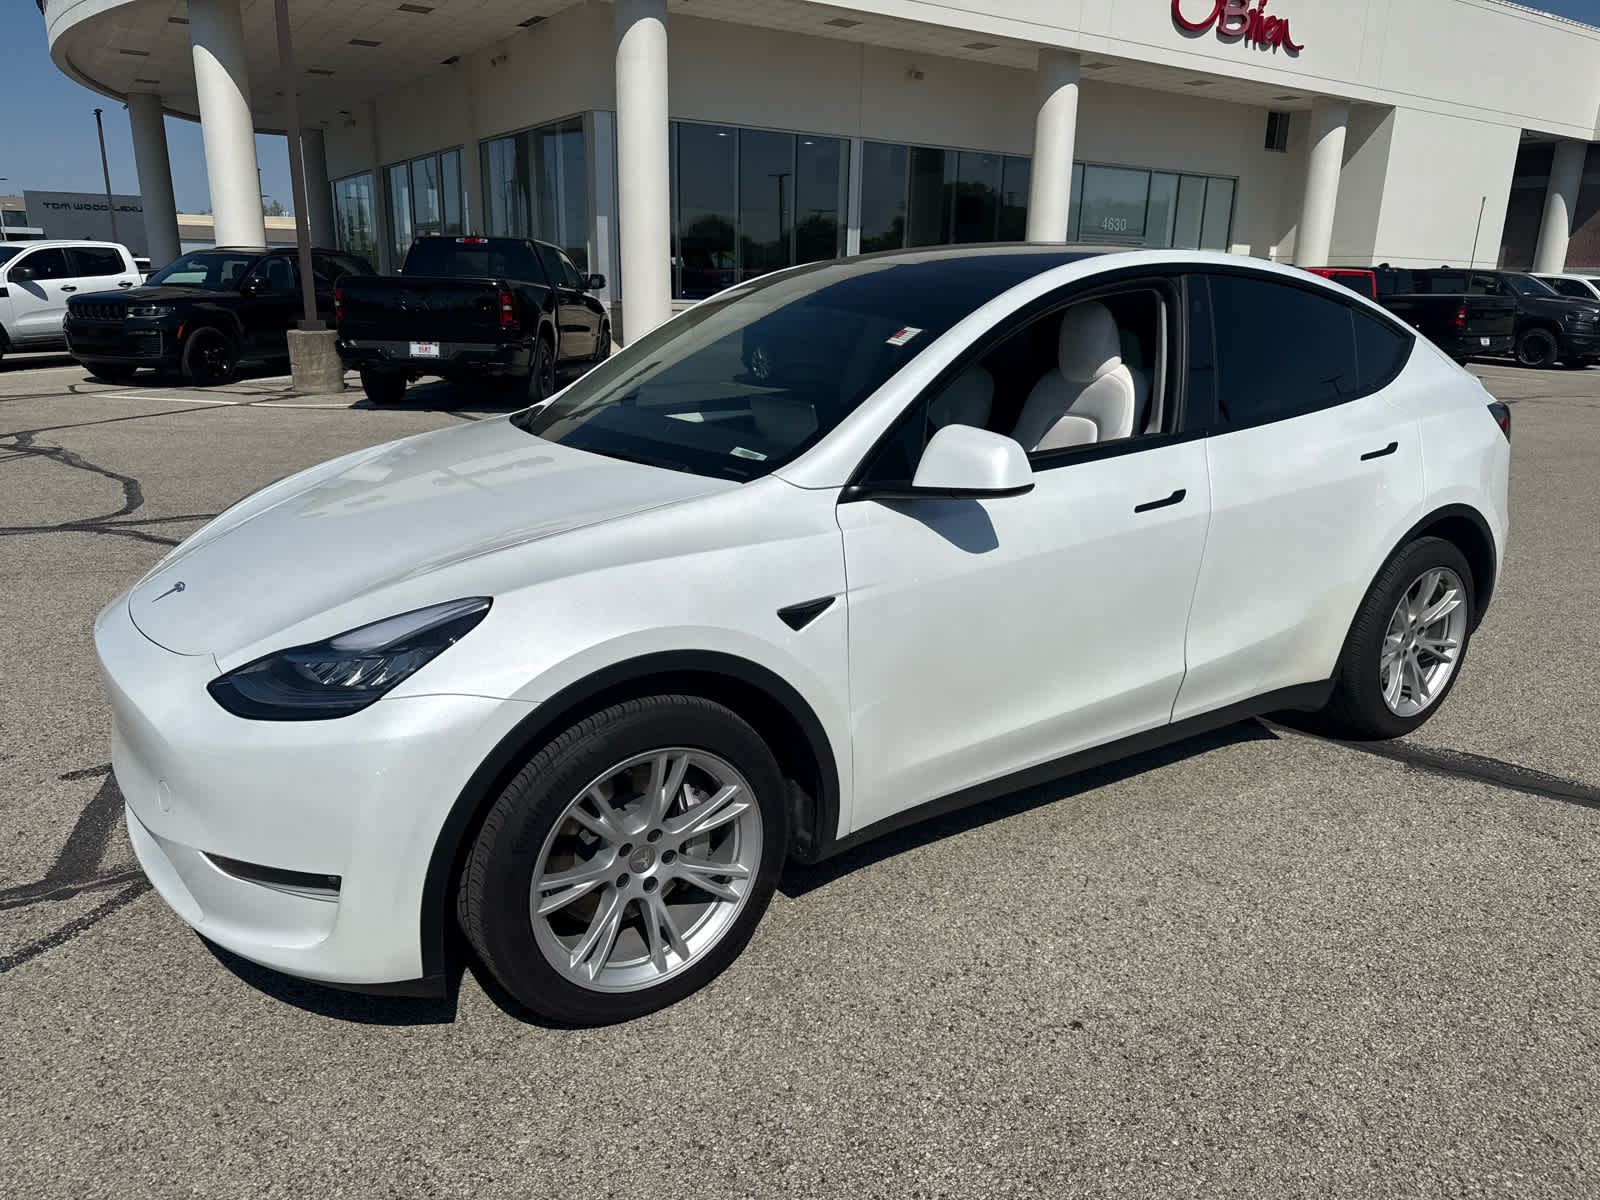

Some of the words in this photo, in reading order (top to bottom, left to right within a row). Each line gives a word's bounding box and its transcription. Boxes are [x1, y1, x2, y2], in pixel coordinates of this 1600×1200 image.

[42, 202, 70, 211] TOM
[111, 204, 143, 213] LEXU
[1101, 216, 1127, 231] 4630
